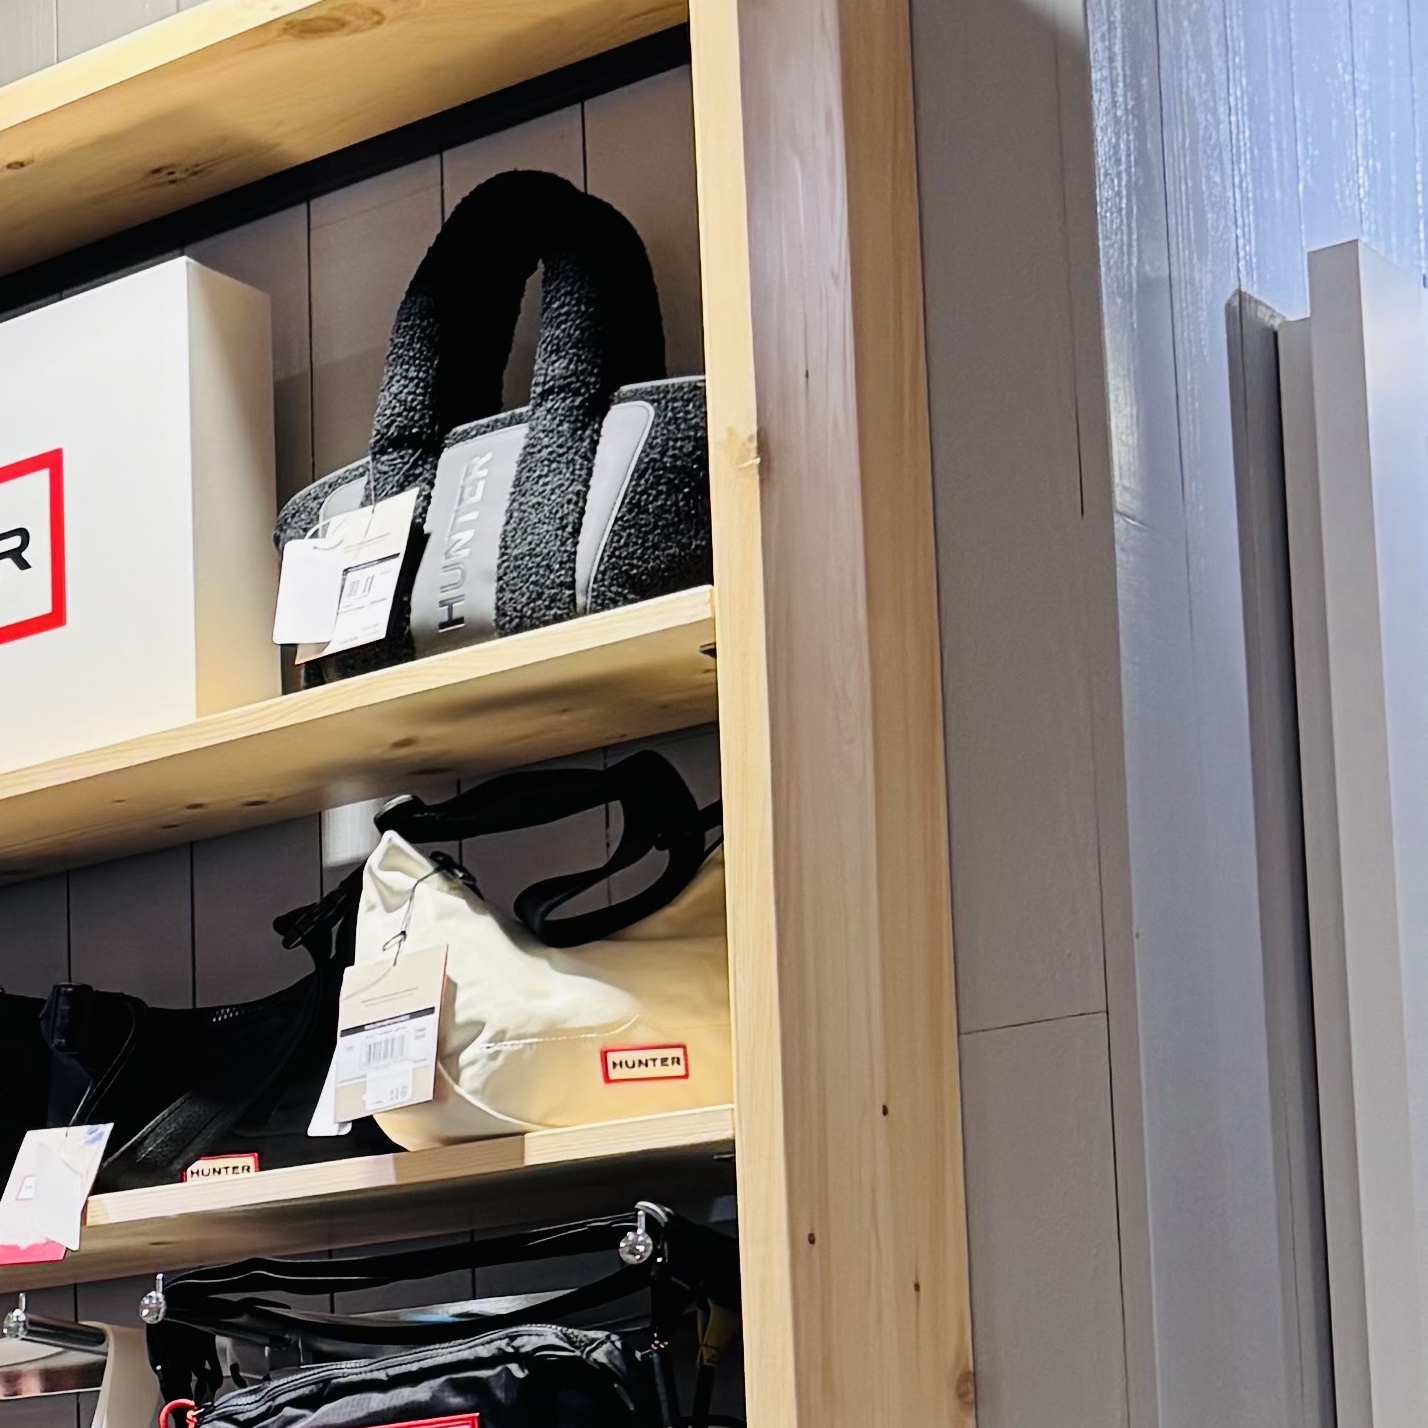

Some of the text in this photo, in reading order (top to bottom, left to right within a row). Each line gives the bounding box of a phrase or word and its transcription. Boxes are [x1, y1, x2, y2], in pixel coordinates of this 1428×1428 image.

[438, 451, 493, 633] HUNTER
[611, 1055, 682, 1070] HUNTER
[190, 1164, 252, 1180] HUNTER
